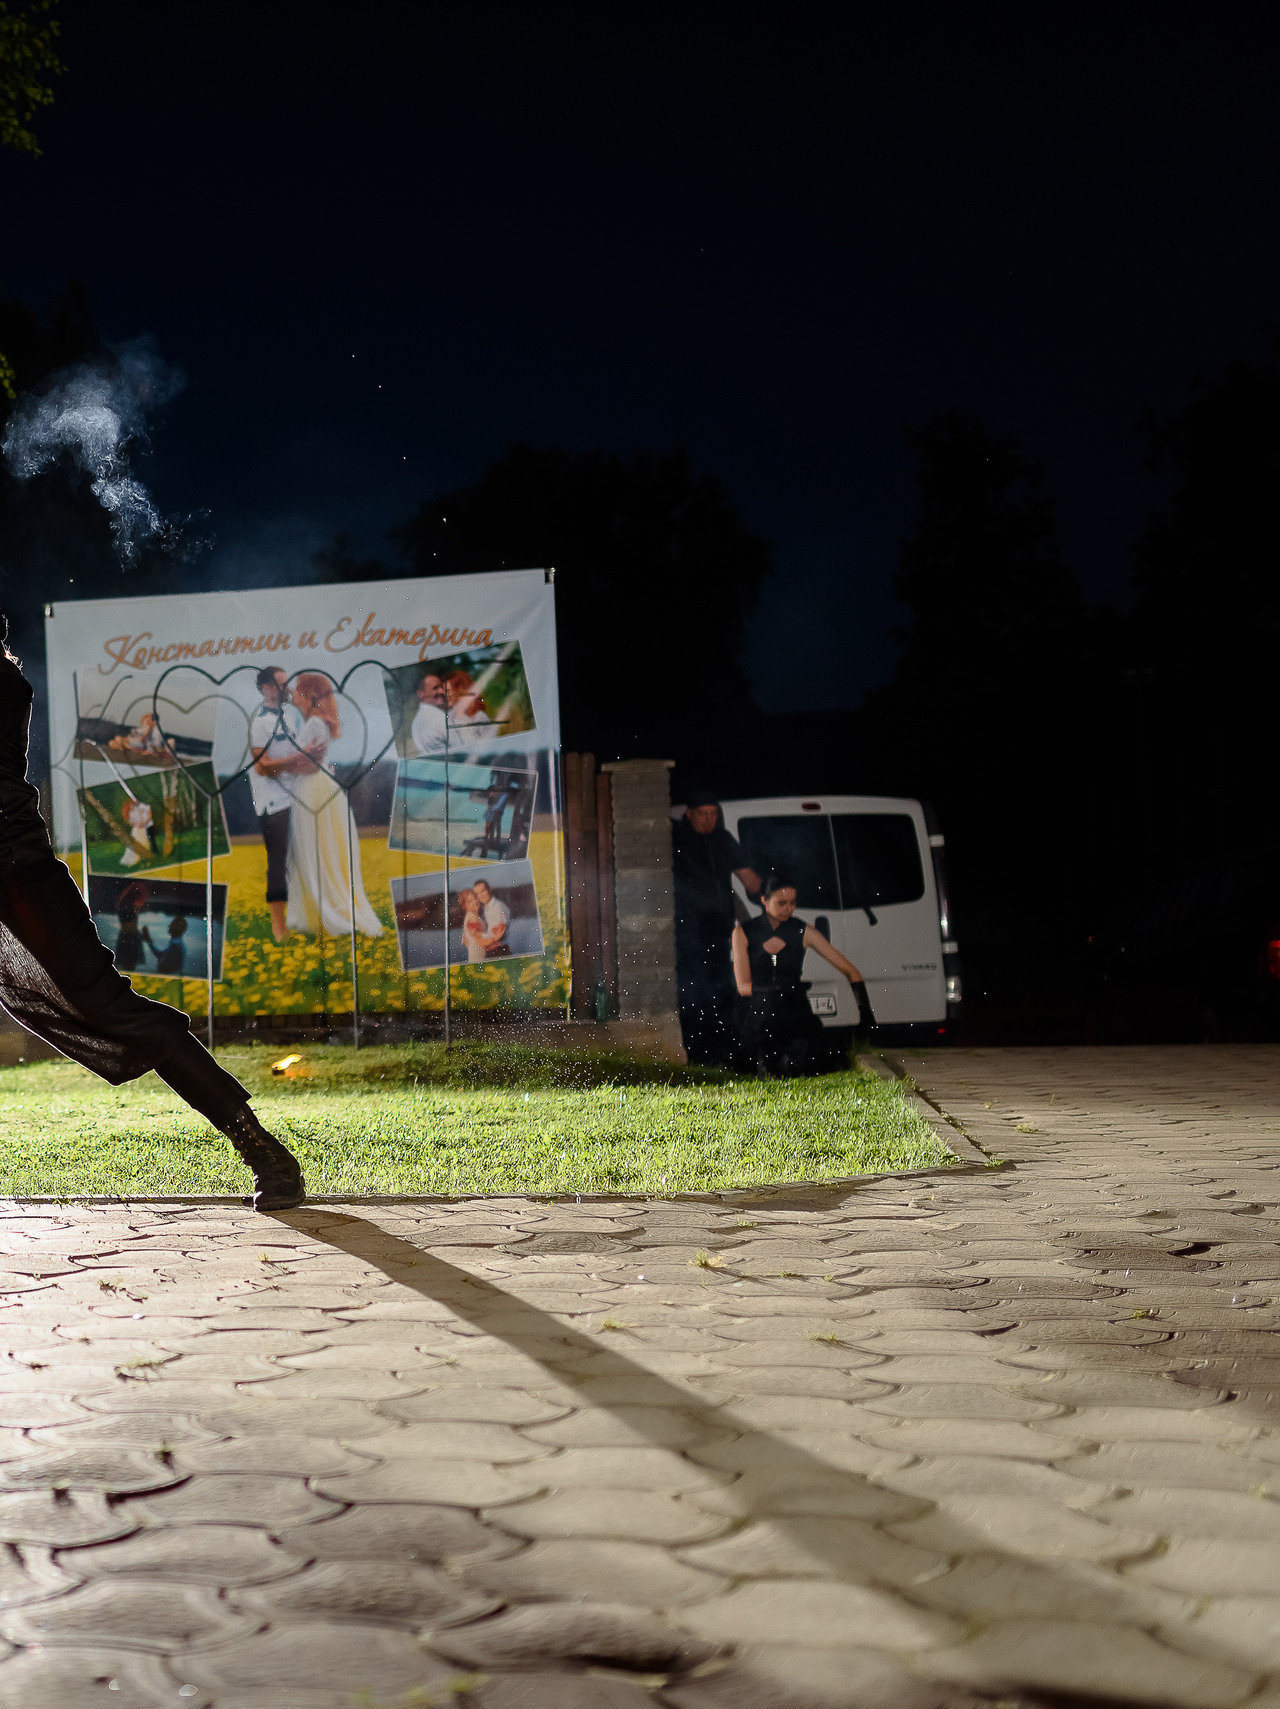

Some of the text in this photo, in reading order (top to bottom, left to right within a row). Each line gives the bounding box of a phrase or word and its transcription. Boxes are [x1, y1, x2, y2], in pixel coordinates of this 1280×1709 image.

[97, 612, 493, 675] Константин и Екатерина
